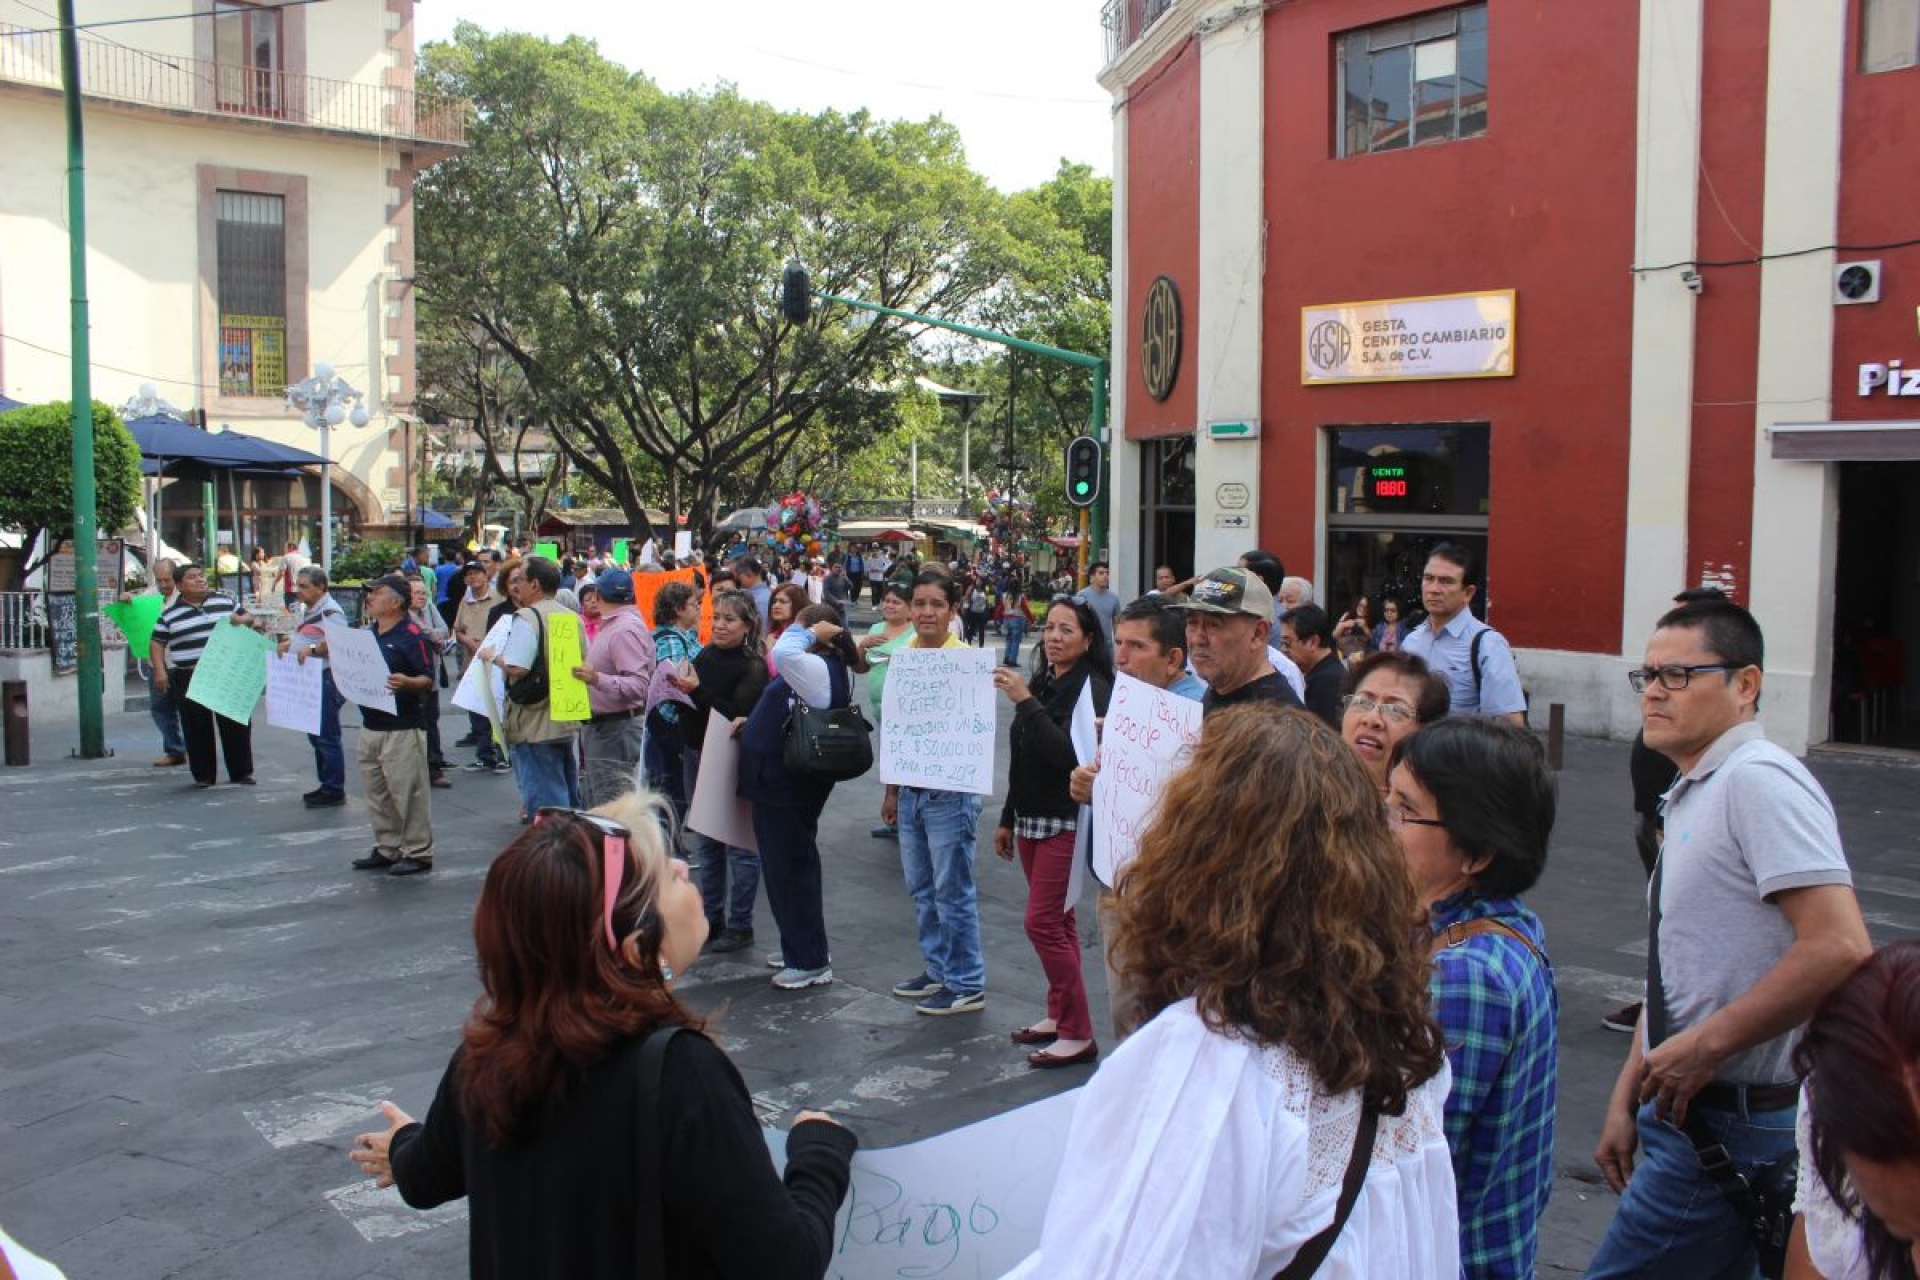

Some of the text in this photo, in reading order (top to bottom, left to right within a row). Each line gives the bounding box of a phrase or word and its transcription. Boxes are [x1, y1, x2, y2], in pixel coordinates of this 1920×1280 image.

[1362, 320, 1407, 332] GESTA
[1362, 327, 1505, 348] CENTRO CAMBIARIO
[1362, 348, 1432, 363] S.A. de C.V.
